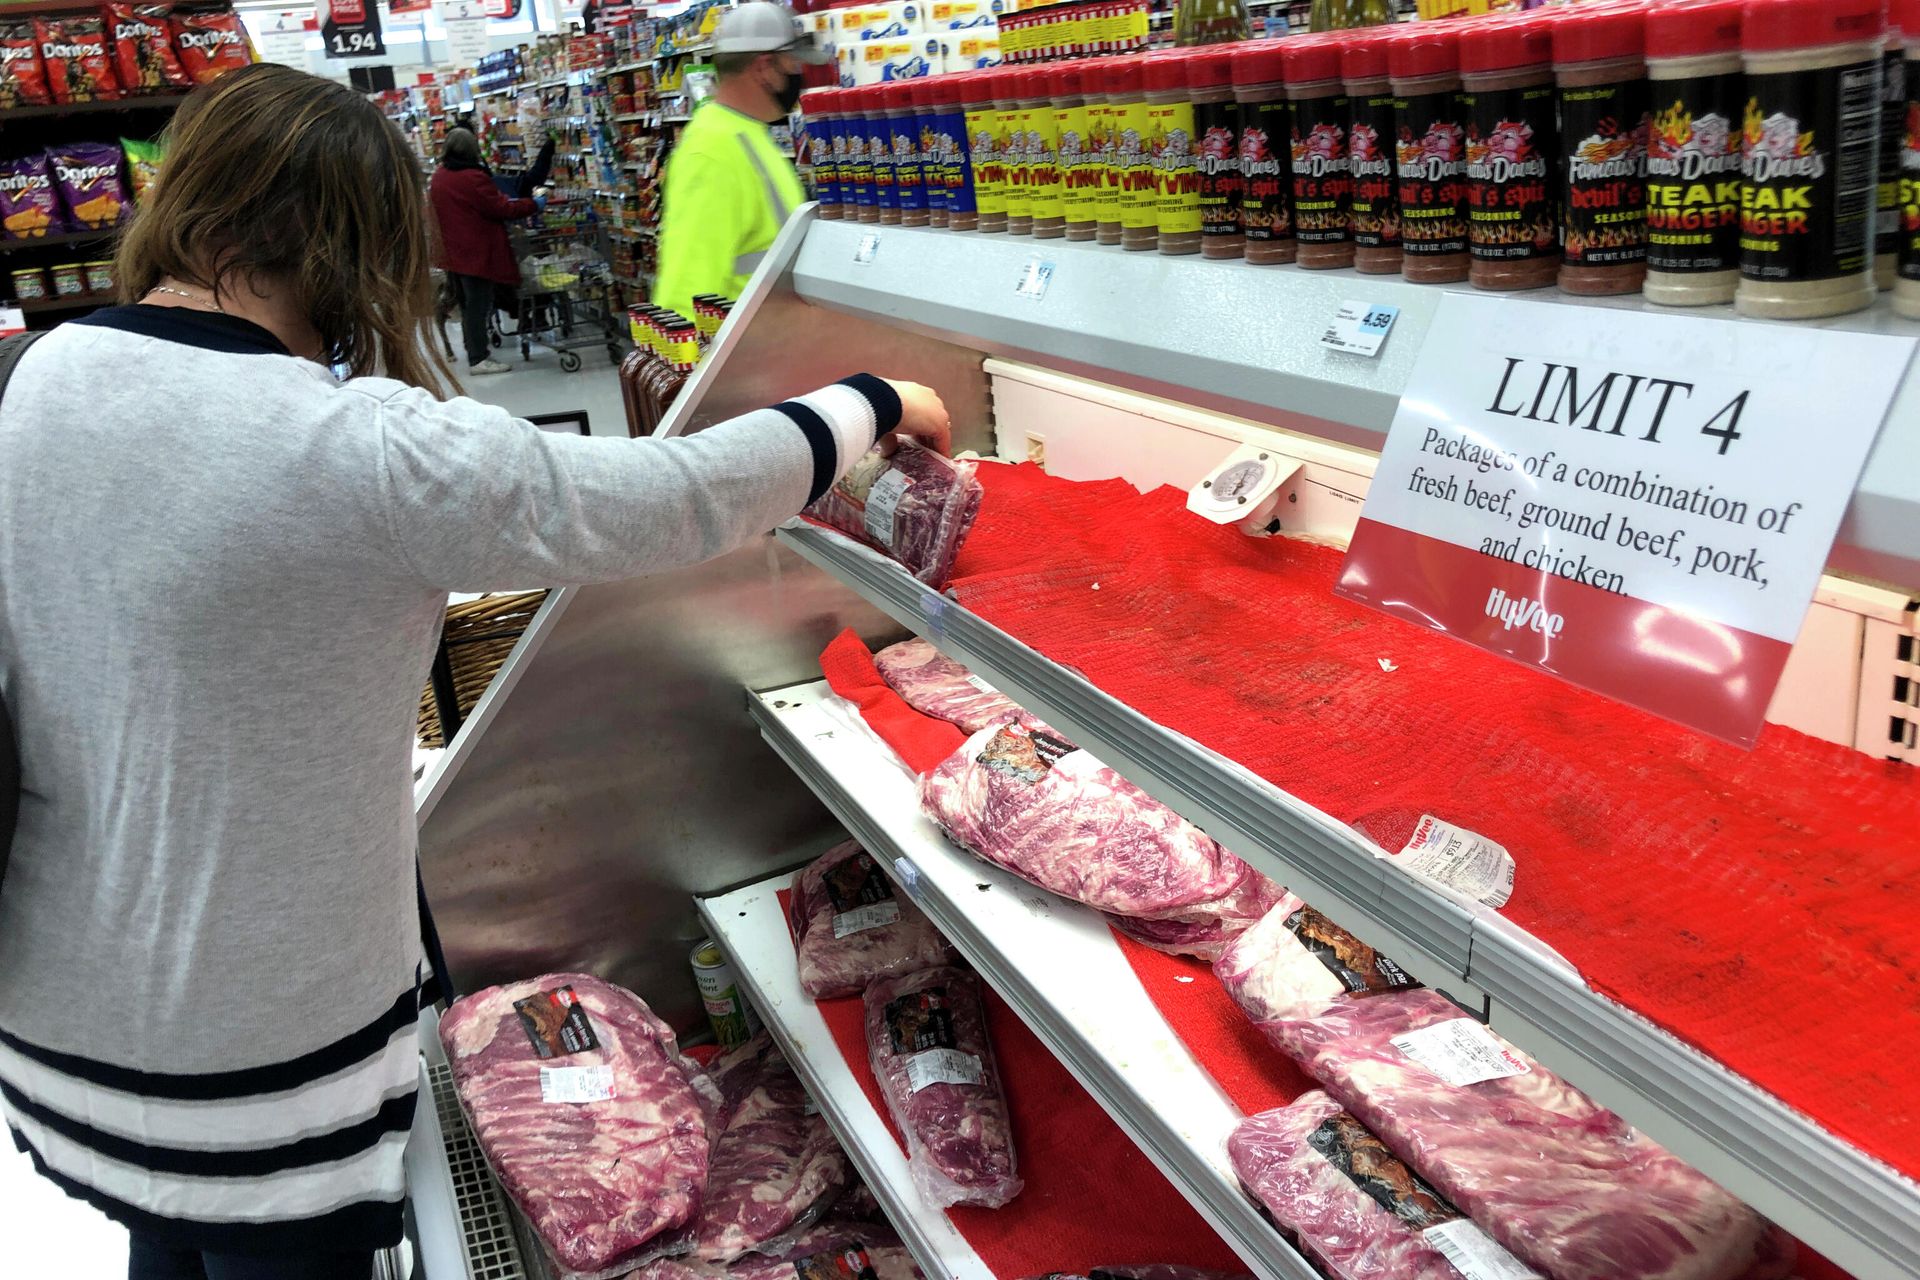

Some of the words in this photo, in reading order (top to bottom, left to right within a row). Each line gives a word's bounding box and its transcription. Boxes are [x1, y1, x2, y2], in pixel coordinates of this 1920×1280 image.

[115, 23, 163, 39] Doritos
[179, 31, 240, 48] Doritos
[332, 32, 377, 53] 1.94
[42, 43, 104, 59] Doritos
[0, 174, 50, 191] oritos
[56, 164, 117, 181] Doritos
[1568, 156, 1636, 184] Famous
[1647, 180, 1741, 206] TEAK
[1740, 184, 1814, 210] EAK
[1647, 203, 1737, 231] URGER
[1362, 312, 1391, 328] 4.59
[1486, 357, 1695, 443] LIMIT
[1700, 390, 1751, 455] 4
[1420, 427, 1518, 473] Packages
[1523, 451, 1556, 478] of
[1552, 463, 1568, 482] a
[1574, 467, 1747, 525] combination
[1757, 503, 1803, 534] of
[1407, 466, 1458, 502] fresh
[1463, 479, 1516, 521] beef,
[1518, 501, 1612, 541] ground
[1616, 516, 1686, 567] beef,
[1688, 545, 1769, 590] pork,
[1479, 536, 1521, 563] and
[1523, 544, 1629, 597] chicken.
[1484, 587, 1565, 638] HyVee
[1409, 818, 1434, 850] HyVee
